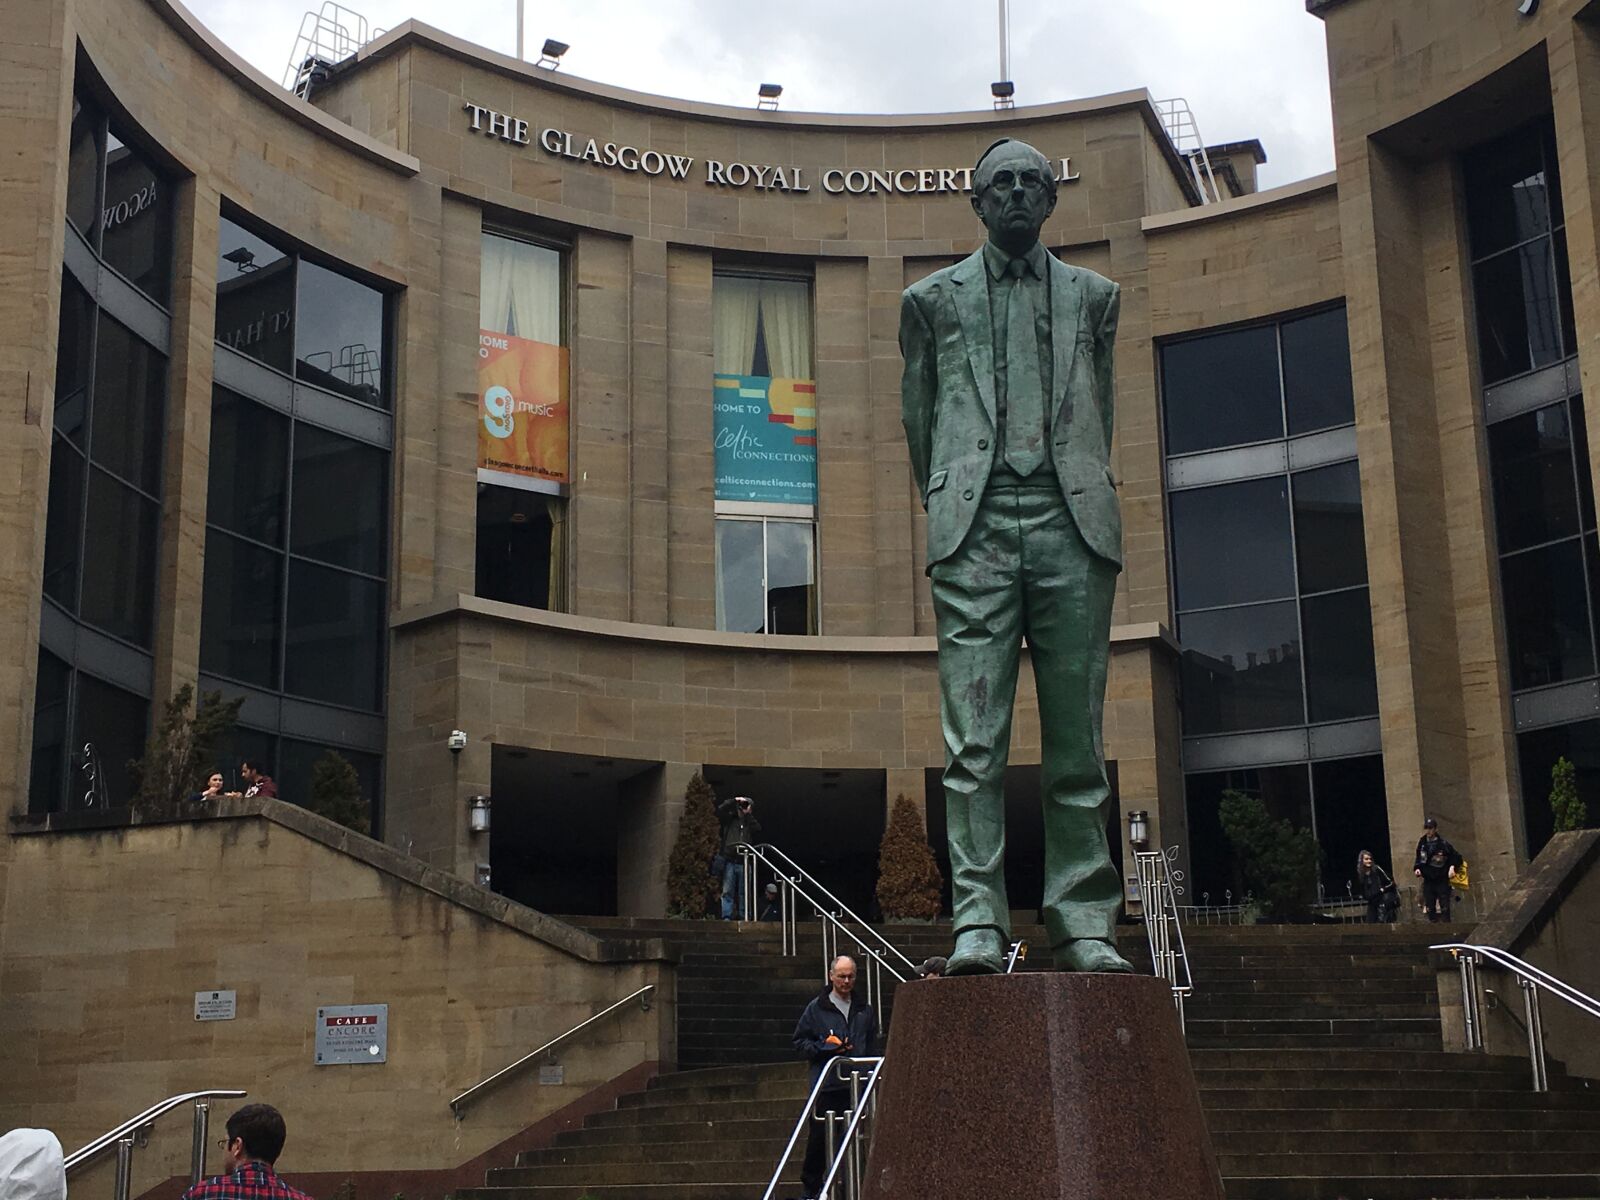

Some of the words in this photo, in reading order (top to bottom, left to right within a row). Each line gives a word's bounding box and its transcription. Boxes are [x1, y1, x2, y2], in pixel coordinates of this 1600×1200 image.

[465, 102, 531, 145] THE
[541, 128, 694, 179] GLASGOW
[706, 159, 810, 192] ROYAL
[822, 166, 975, 194] CONCERT
[480, 347, 489, 359] O
[518, 401, 554, 418] music
[714, 403, 744, 413] HOME
[747, 405, 761, 414] TO
[715, 425, 763, 459] Celtic
[737, 450, 816, 463] CONNECTIONS
[714, 475, 816, 489] celticconnections.com
[336, 1017, 368, 1025] CAFE
